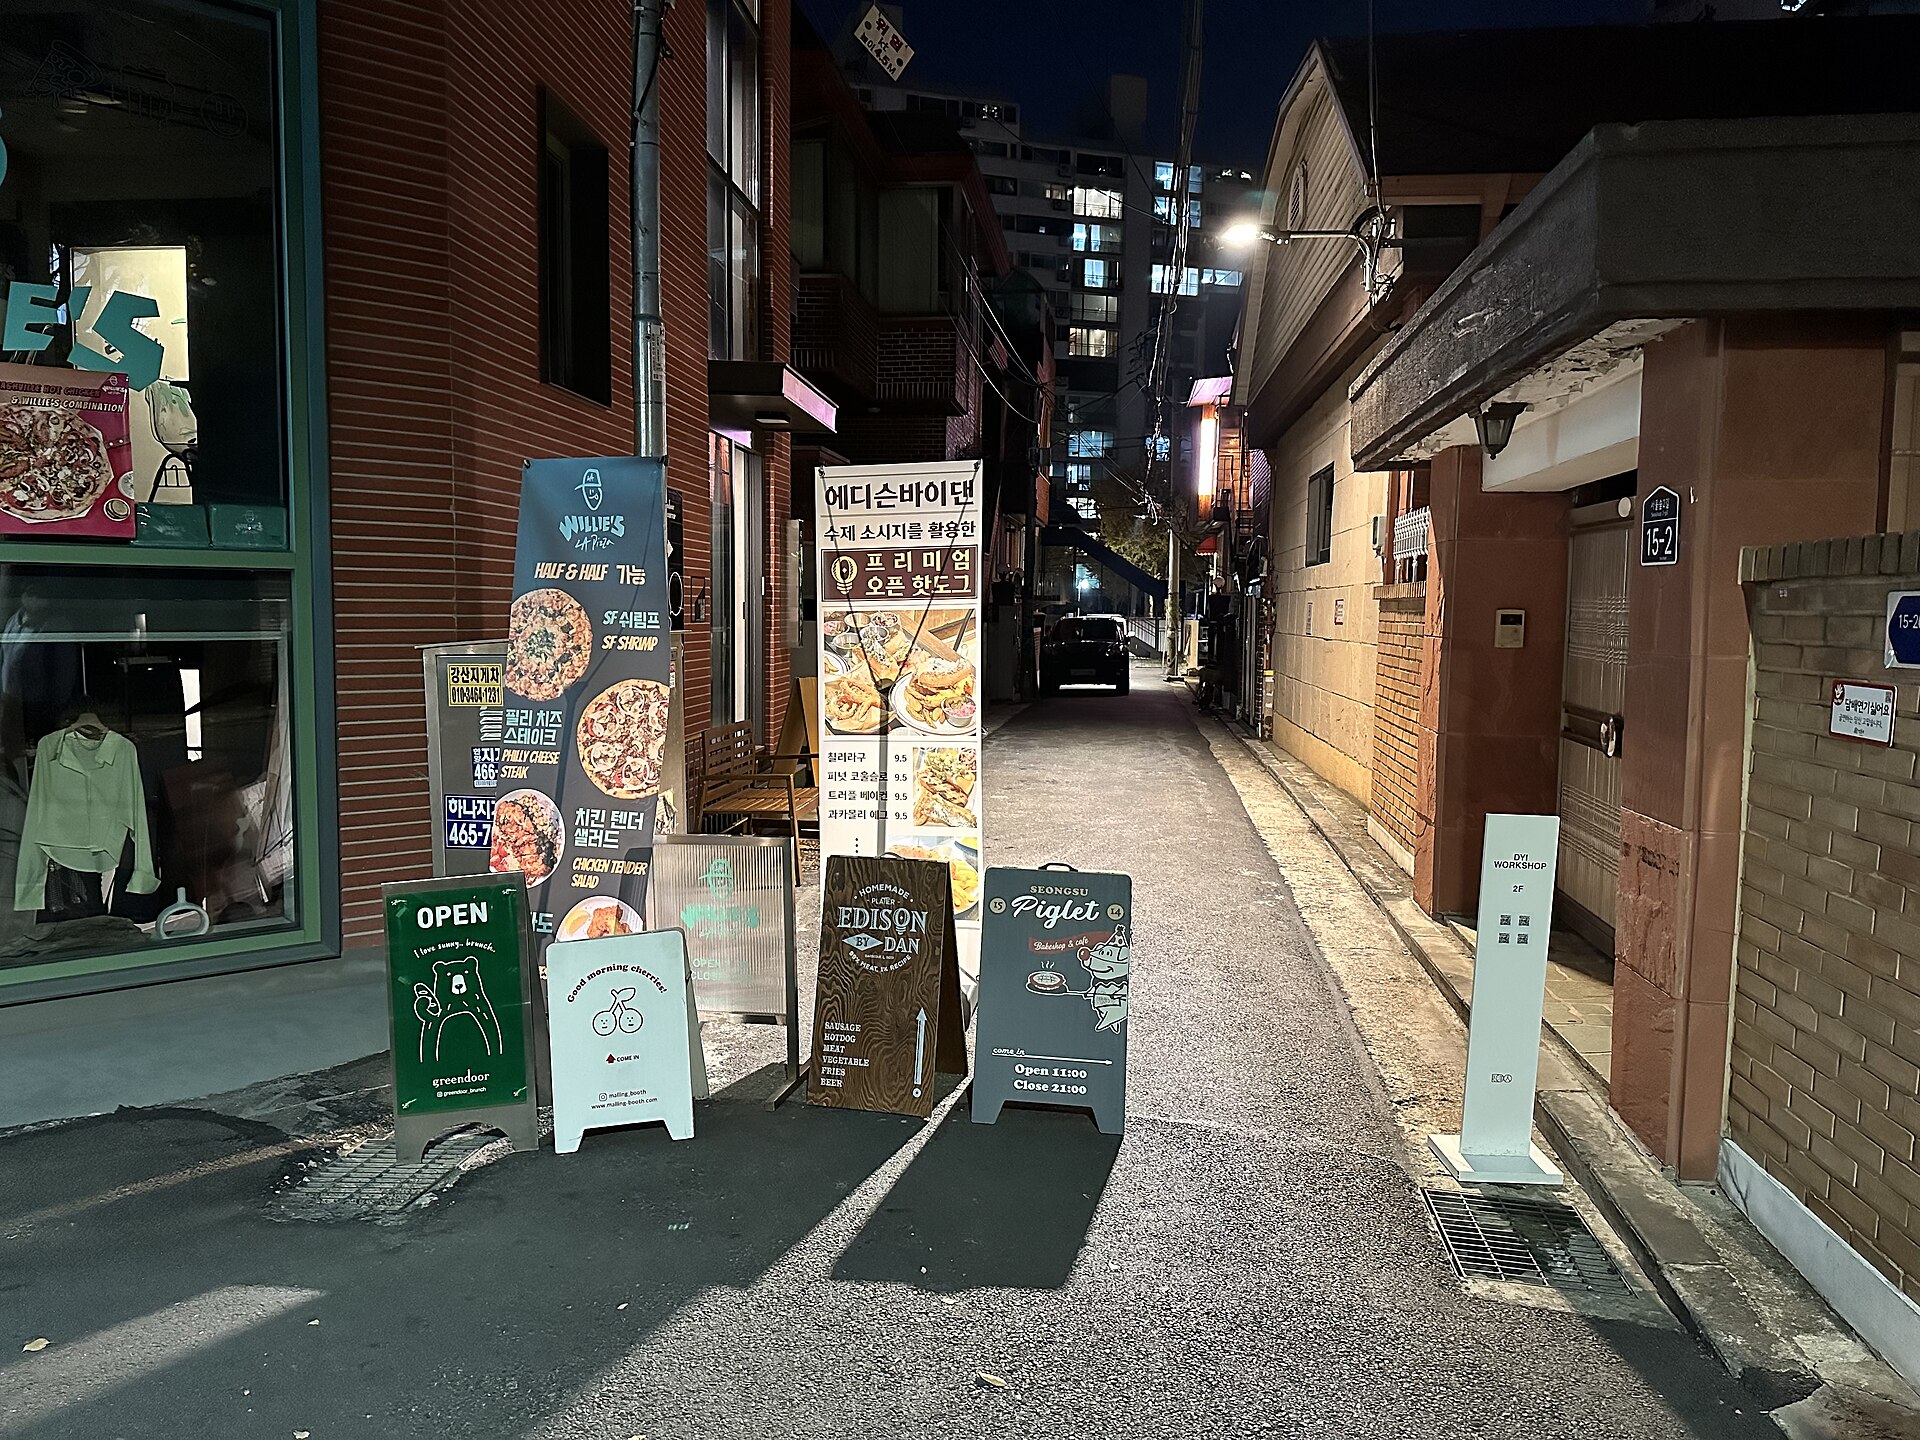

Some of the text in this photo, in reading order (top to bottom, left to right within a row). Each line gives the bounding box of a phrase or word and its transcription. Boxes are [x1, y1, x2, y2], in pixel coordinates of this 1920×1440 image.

[876, 18, 904, 53] 위험
[43, 386, 62, 394] HOT
[64, 388, 101, 398] CHICKEN
[11, 396, 124, 412] & WILLIE'S COMBINATION
[825, 479, 974, 510] 에디슨바이댄
[559, 515, 625, 541] WILLIE'S
[824, 520, 976, 542] 수제 소시지를 활용한
[591, 534, 614, 551] Pizza
[1646, 526, 1672, 556] 15-2
[534, 562, 646, 585] HALF & HALF 가능
[866, 574, 972, 596] 오픈 핫도그
[603, 610, 660, 629] SF 쉬림프
[1899, 614, 1920, 628] 15-2
[602, 636, 658, 651] SF SHRIMP
[451, 667, 500, 685] 강산지게차
[452, 686, 500, 704] 010-3464-1231
[505, 708, 562, 728] 필리 치즈
[503, 728, 557, 746] 스테이크
[502, 748, 560, 765] PHILLY CHEESE
[828, 752, 907, 764] 칠리라구 9.5
[500, 765, 528, 778] STEAK
[827, 770, 848, 782] 피넛
[894, 773, 908, 782] 9.5
[828, 790, 908, 802] 트러플 베이컨 9.5
[448, 798, 495, 820] 하나지
[828, 809, 908, 820] 과카몰리 에그 9.5
[574, 808, 644, 830] 치킨 텐더
[574, 828, 620, 848] 샐러드
[573, 857, 648, 876] CHICKEN TENDER
[1494, 861, 1546, 870] WORKSHOP
[571, 874, 600, 888] SALAD
[859, 884, 910, 900] HOMEMADE
[1030, 886, 1088, 896] SEONGSU
[994, 902, 1003, 910] 15
[1012, 895, 1100, 929] Piglet
[1110, 908, 1122, 917] 14
[417, 902, 488, 929] OPEN
[837, 906, 928, 935] EDISON
[856, 936, 920, 954] BY DAN
[1034, 942, 1066, 950] Bakeshop
[1075, 936, 1088, 946] cafe
[414, 950, 420, 958] I
[420, 946, 436, 955] love
[692, 959, 720, 968] OPEN
[890, 954, 912, 971] RECIPE
[568, 964, 667, 1002] Good morning cherries!
[824, 1022, 862, 1032] SAUSAGE
[824, 1034, 856, 1043] HOTDOG
[823, 1045, 845, 1054] MEAT
[1016, 1048, 1026, 1056] in
[822, 1056, 870, 1067] VEGETABLE
[432, 1069, 490, 1088] greendoor
[822, 1067, 846, 1076] FRIES
[1015, 1064, 1087, 1078] Open 11:00
[820, 1078, 843, 1088] BEER
[1014, 1080, 1086, 1094] Close 21:00
